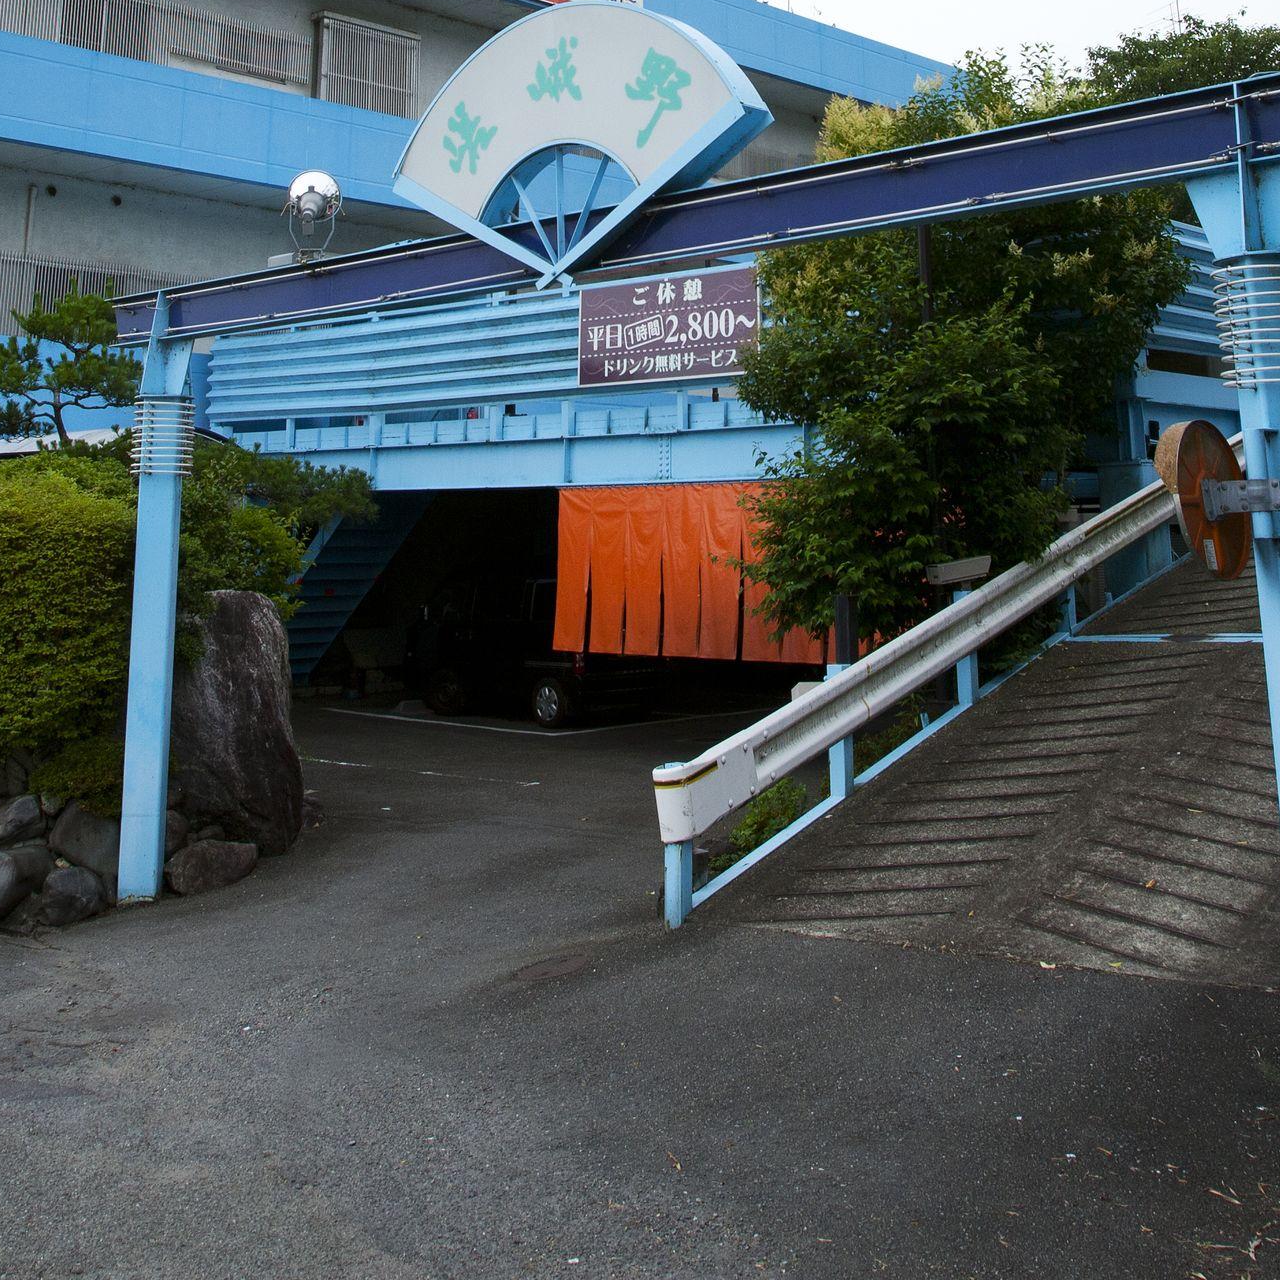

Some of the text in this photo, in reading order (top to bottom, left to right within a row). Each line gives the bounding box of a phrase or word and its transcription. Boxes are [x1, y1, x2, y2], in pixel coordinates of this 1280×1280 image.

[632, 278, 703, 306] ご休憩
[587, 324, 622, 351] 平日
[604, 348, 738, 377] ドリンク無料サービス
